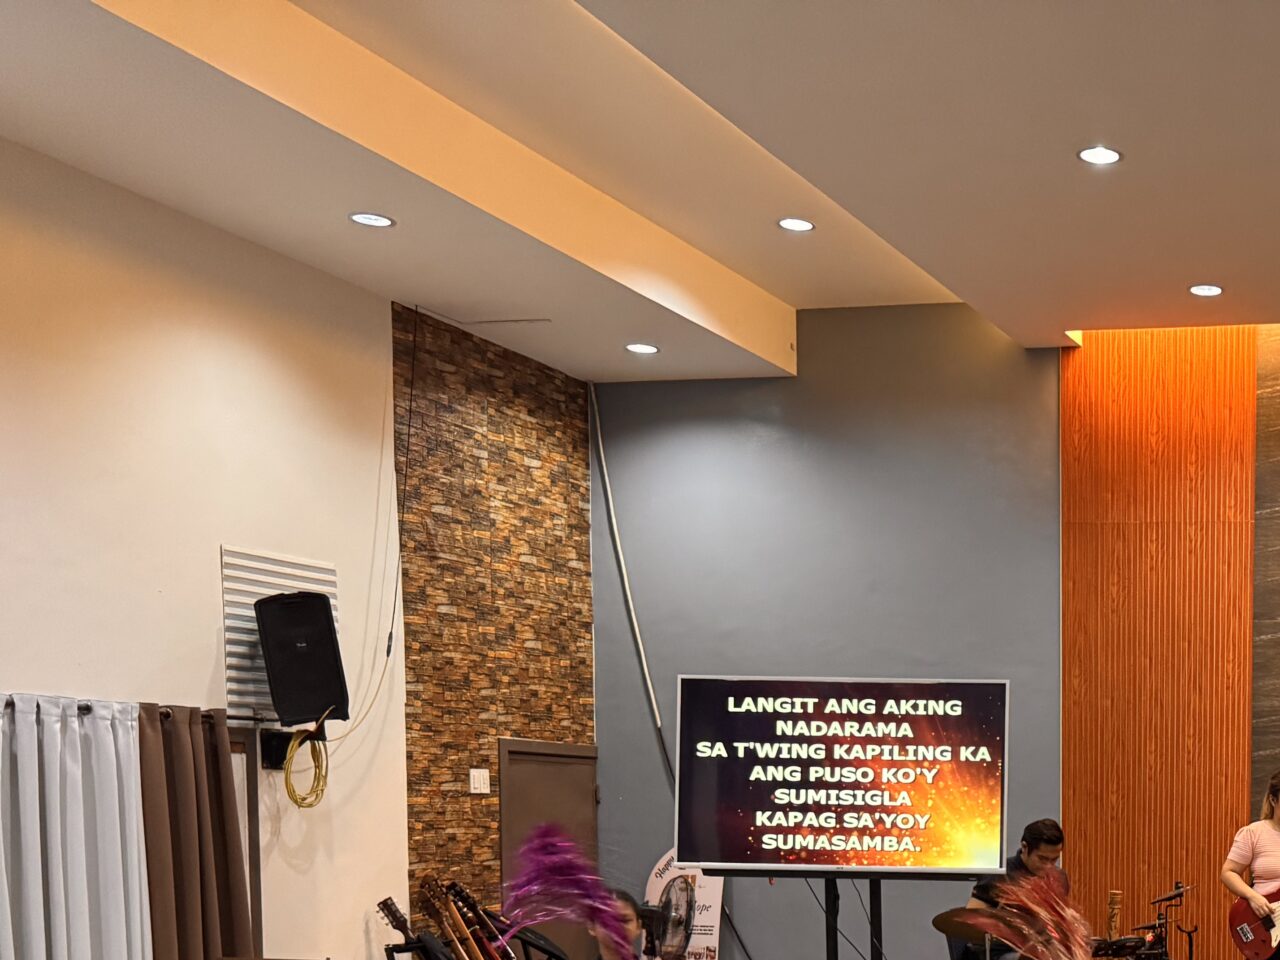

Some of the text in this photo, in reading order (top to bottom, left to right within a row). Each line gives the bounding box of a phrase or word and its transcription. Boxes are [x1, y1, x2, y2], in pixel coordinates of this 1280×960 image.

[727, 696, 963, 716] LANGIT ANG AKING
[775, 720, 914, 738] NADARAMA
[696, 741, 991, 762] SA T'WING KAPILING KA
[748, 765, 938, 785] ANG PUSO KO'Y
[774, 788, 912, 806] SUMISIGLA
[755, 810, 930, 830] KAPAG SA'YOY
[761, 833, 922, 852] SUMASAMBA.
[695, 902, 712, 915] ope
